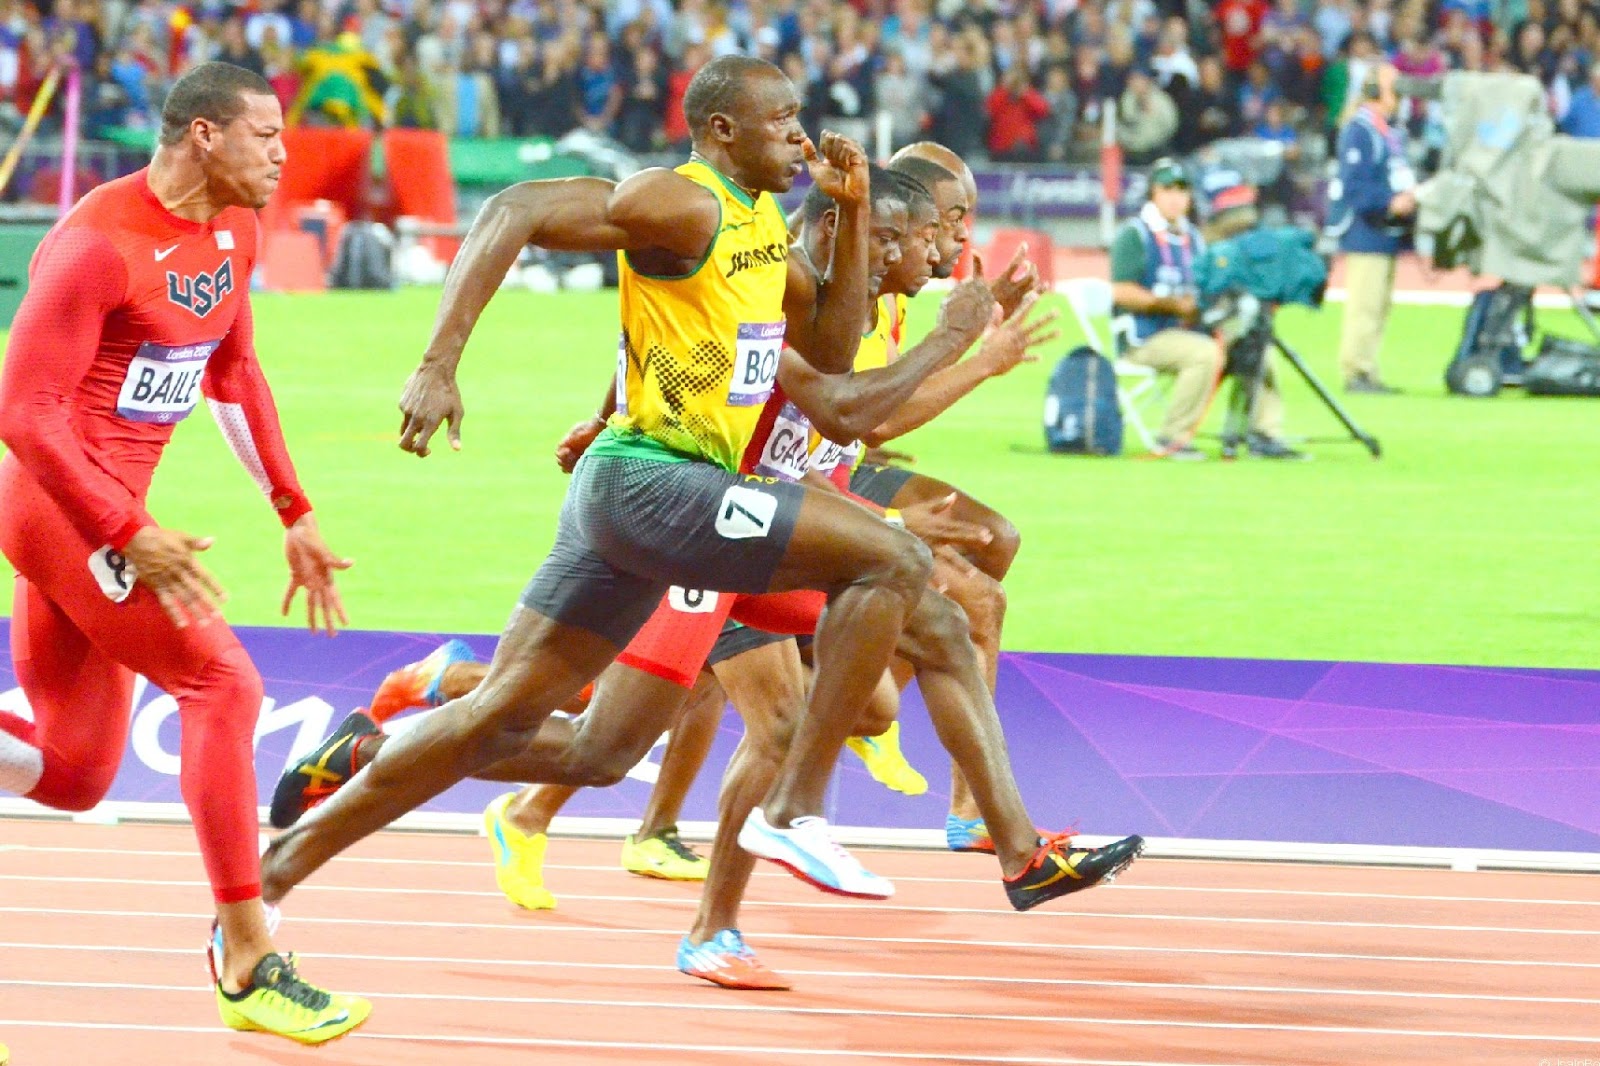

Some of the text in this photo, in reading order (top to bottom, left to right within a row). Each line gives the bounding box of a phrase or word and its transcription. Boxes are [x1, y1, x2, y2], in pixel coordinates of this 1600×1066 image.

[166, 256, 234, 319] USA
[165, 345, 194, 360] London
[724, 500, 764, 529] 7
